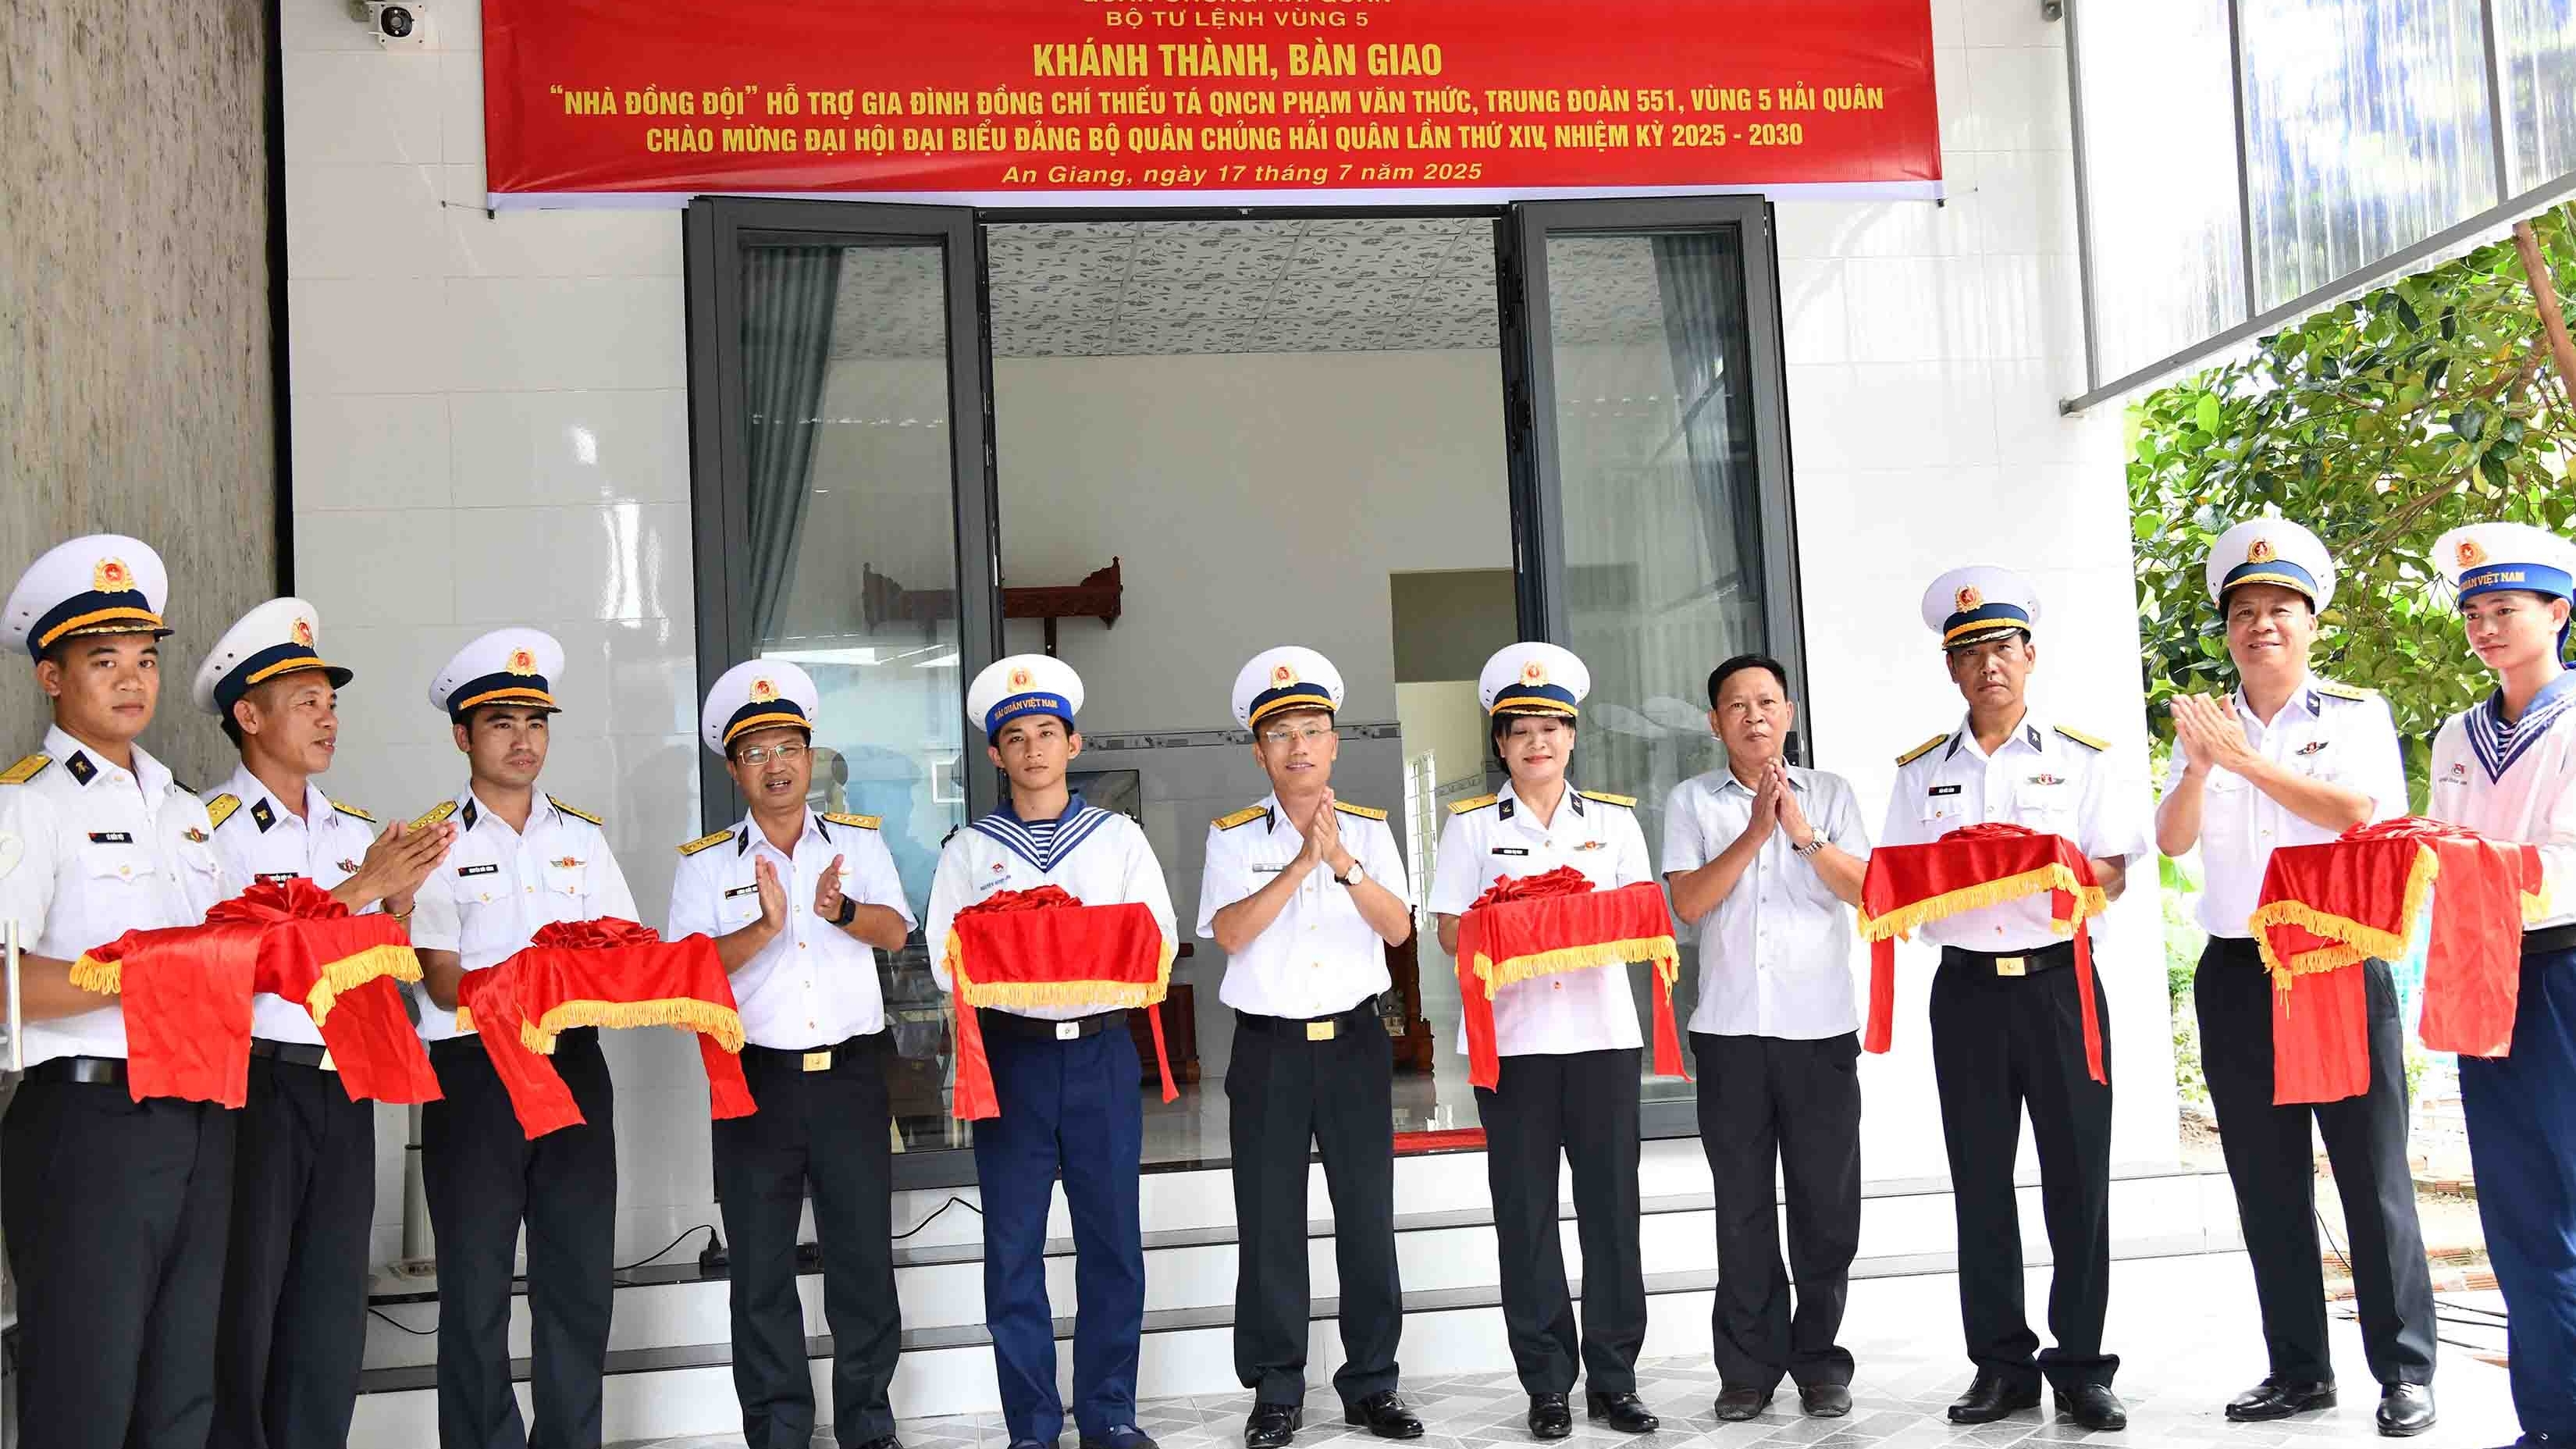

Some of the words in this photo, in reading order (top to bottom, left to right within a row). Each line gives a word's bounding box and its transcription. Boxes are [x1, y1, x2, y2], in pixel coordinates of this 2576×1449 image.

[1106, 7, 1143, 29] BỘ
[1151, 9, 1186, 27] TƯ
[1195, 8, 1264, 27] LỆNH
[1274, 6, 1346, 27] VÙNG
[1356, 12, 1368, 27] 5
[1033, 37, 1148, 77] KHÁNH
[1158, 37, 1279, 81] THÀNH,
[1288, 37, 1357, 77] BÀN
[1367, 43, 1443, 77] GIAO
[550, 84, 617, 115] “NHÀ
[624, 83, 694, 116] ĐỒNG
[702, 85, 758, 120] ĐỘI”
[767, 83, 799, 116] HỖ
[806, 89, 854, 120] TRỢ
[862, 91, 903, 116] GIA
[909, 87, 970, 116] ĐÌNH
[976, 84, 1044, 115] ĐỒNG
[1051, 87, 1091, 115] CHÍ
[1098, 84, 1166, 114] THIẾU
[1172, 87, 1203, 115] TÁ
[1209, 91, 1276, 117] QNCN
[1283, 91, 1351, 119] PHẠM
[1357, 86, 1406, 114] VĂN
[1411, 85, 1478, 116] THỨC,
[1485, 89, 1560, 112] TRUNG
[1567, 84, 1630, 112] ĐOÀN
[1636, 89, 1685, 114] 551,
[1690, 85, 1752, 112] VÙNG
[1758, 88, 1772, 111] 5
[1777, 80, 1816, 111] HẢI
[1823, 82, 1884, 112] QUÂN
[646, 123, 713, 152] CHÀO
[722, 123, 797, 152] MỪNG
[804, 128, 846, 156] ĐẠI
[854, 123, 895, 156] HỘI
[902, 128, 944, 156] ĐẠI
[952, 118, 1007, 151] BIỂU
[1013, 119, 1081, 151] ĐẢNG
[1088, 122, 1120, 156] BỘ
[1128, 122, 1194, 154] QUÂN
[1201, 119, 1282, 151] CHỦNG
[1289, 119, 1328, 150] HẢI
[1336, 121, 1400, 152] QUÂN
[1406, 118, 1451, 149] LẦN
[1457, 120, 1503, 149] THỨ
[1508, 125, 1548, 151] XIV,
[1554, 119, 1629, 153] NHIỆM
[1635, 119, 1664, 148] KỲ
[1671, 123, 1726, 147] 2025
[1749, 123, 1803, 146] 2030
[1002, 166, 1037, 183] An
[1048, 166, 1132, 187] Giang,
[1144, 165, 1208, 187] ngày
[1219, 165, 1247, 182] 17
[1255, 166, 1328, 185] tháng
[1340, 164, 1353, 180] 7
[1361, 165, 1414, 180] năm
[1423, 162, 1482, 180] 2025
[2478, 572, 2500, 586] VIỆT
[1004, 702, 1023, 714] QUÂN
[1023, 697, 1041, 710] VIỆT
[1042, 698, 1058, 709] NAM
